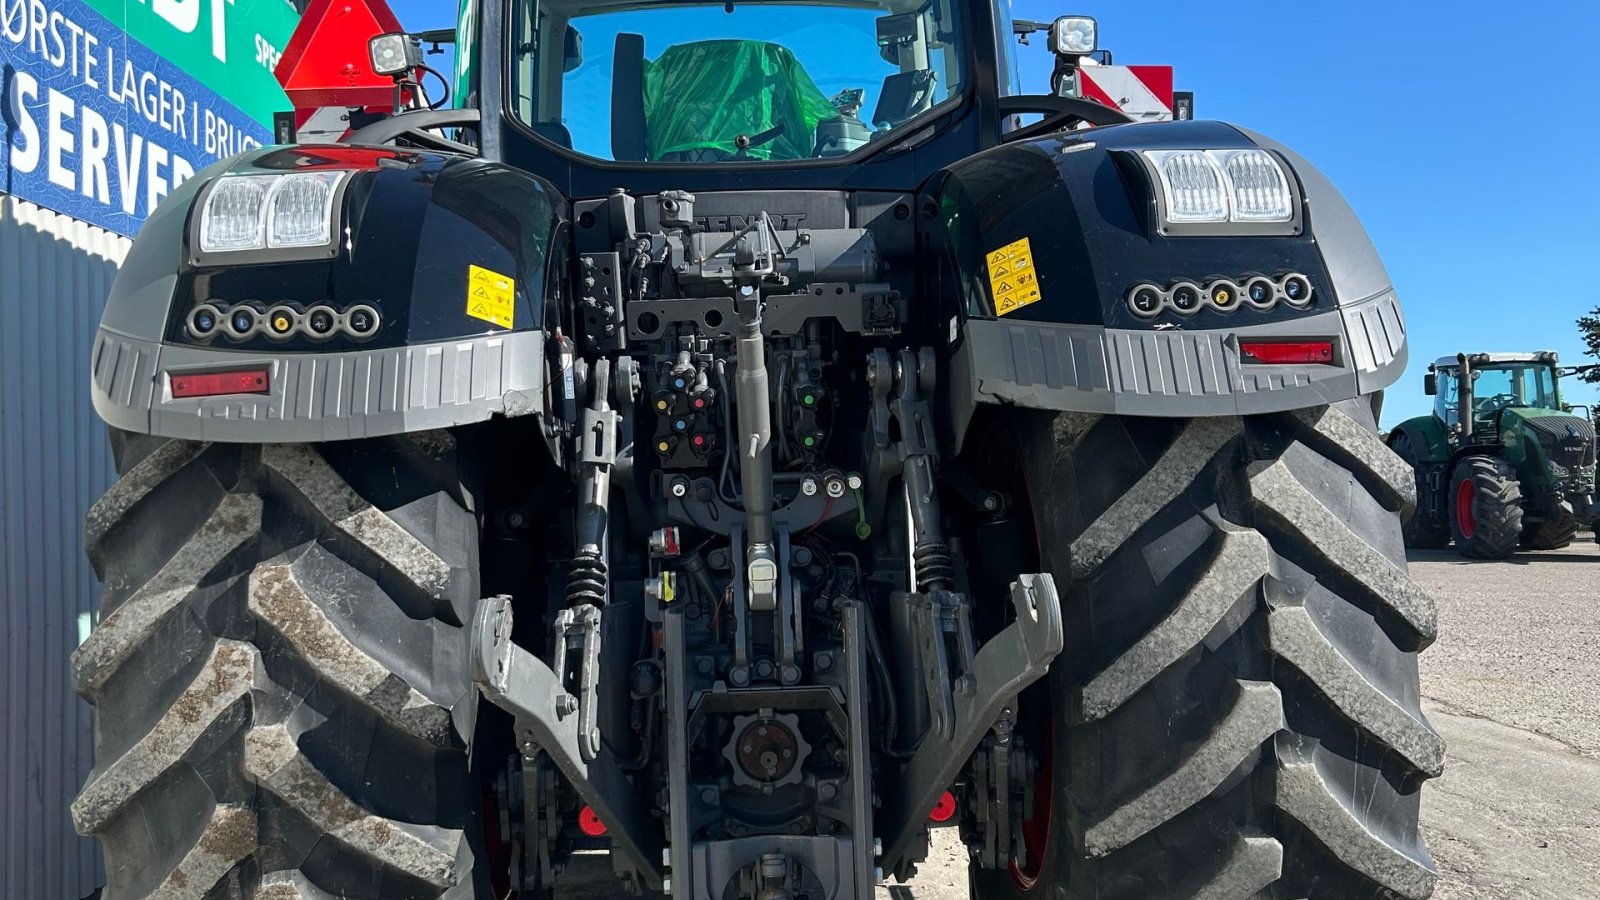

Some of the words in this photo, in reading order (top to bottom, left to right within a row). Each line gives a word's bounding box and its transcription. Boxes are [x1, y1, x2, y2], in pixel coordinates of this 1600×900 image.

[1, 0, 98, 89] ØRSTE
[108, 47, 187, 139] LAGER
[192, 101, 198, 145] I
[205, 108, 264, 159] BRU
